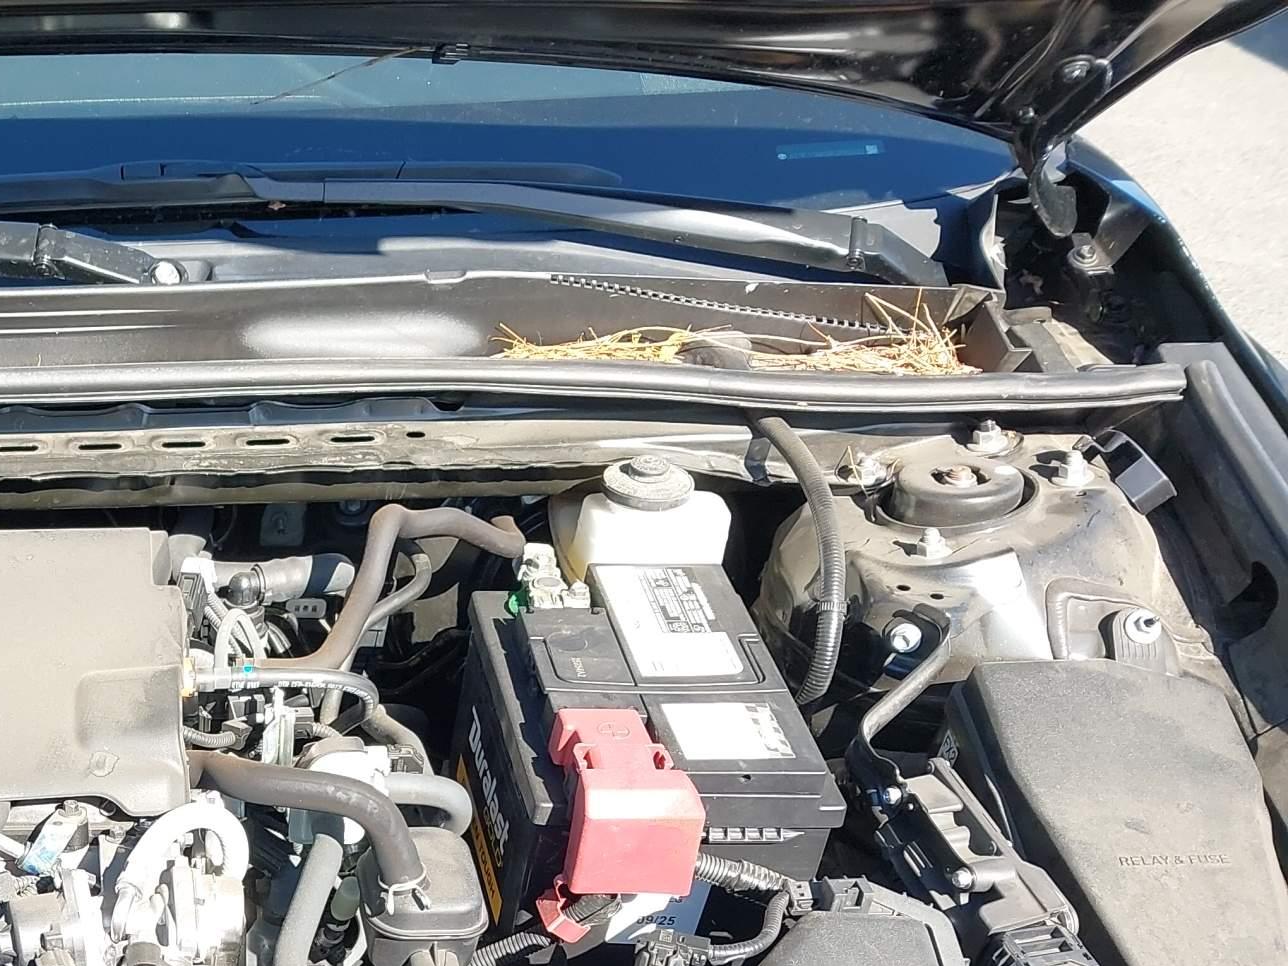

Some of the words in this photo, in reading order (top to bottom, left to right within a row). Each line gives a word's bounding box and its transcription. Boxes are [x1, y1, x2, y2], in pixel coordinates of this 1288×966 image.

[468, 705, 510, 856] Duralast
[482, 806, 503, 868] GOLD
[1118, 855, 1169, 867] RELAY
[1174, 855, 1185, 866] &
[1187, 853, 1230, 866] FUSE
[478, 846, 496, 898] TOUGH
